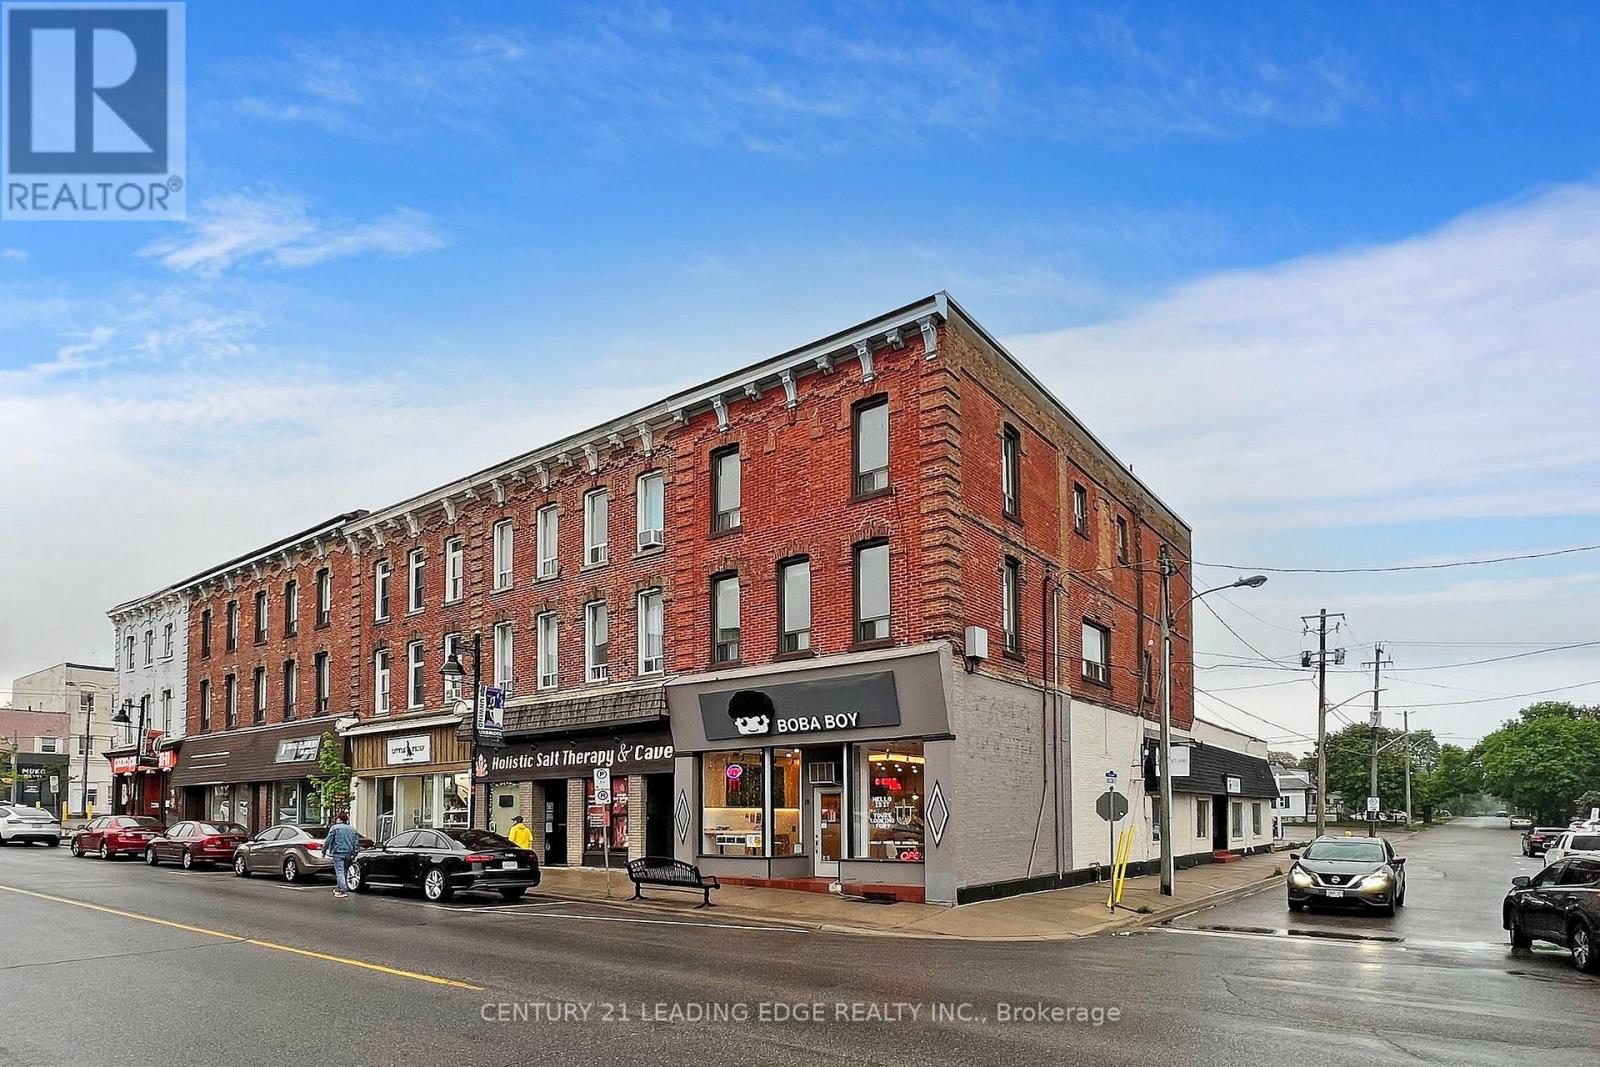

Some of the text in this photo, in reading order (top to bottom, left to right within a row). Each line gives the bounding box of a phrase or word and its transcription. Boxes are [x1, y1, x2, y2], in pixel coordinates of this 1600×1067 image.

[777, 712, 858, 732] BOBA BOY
[492, 743, 674, 770] Holistic Salt Therapy & Cave
